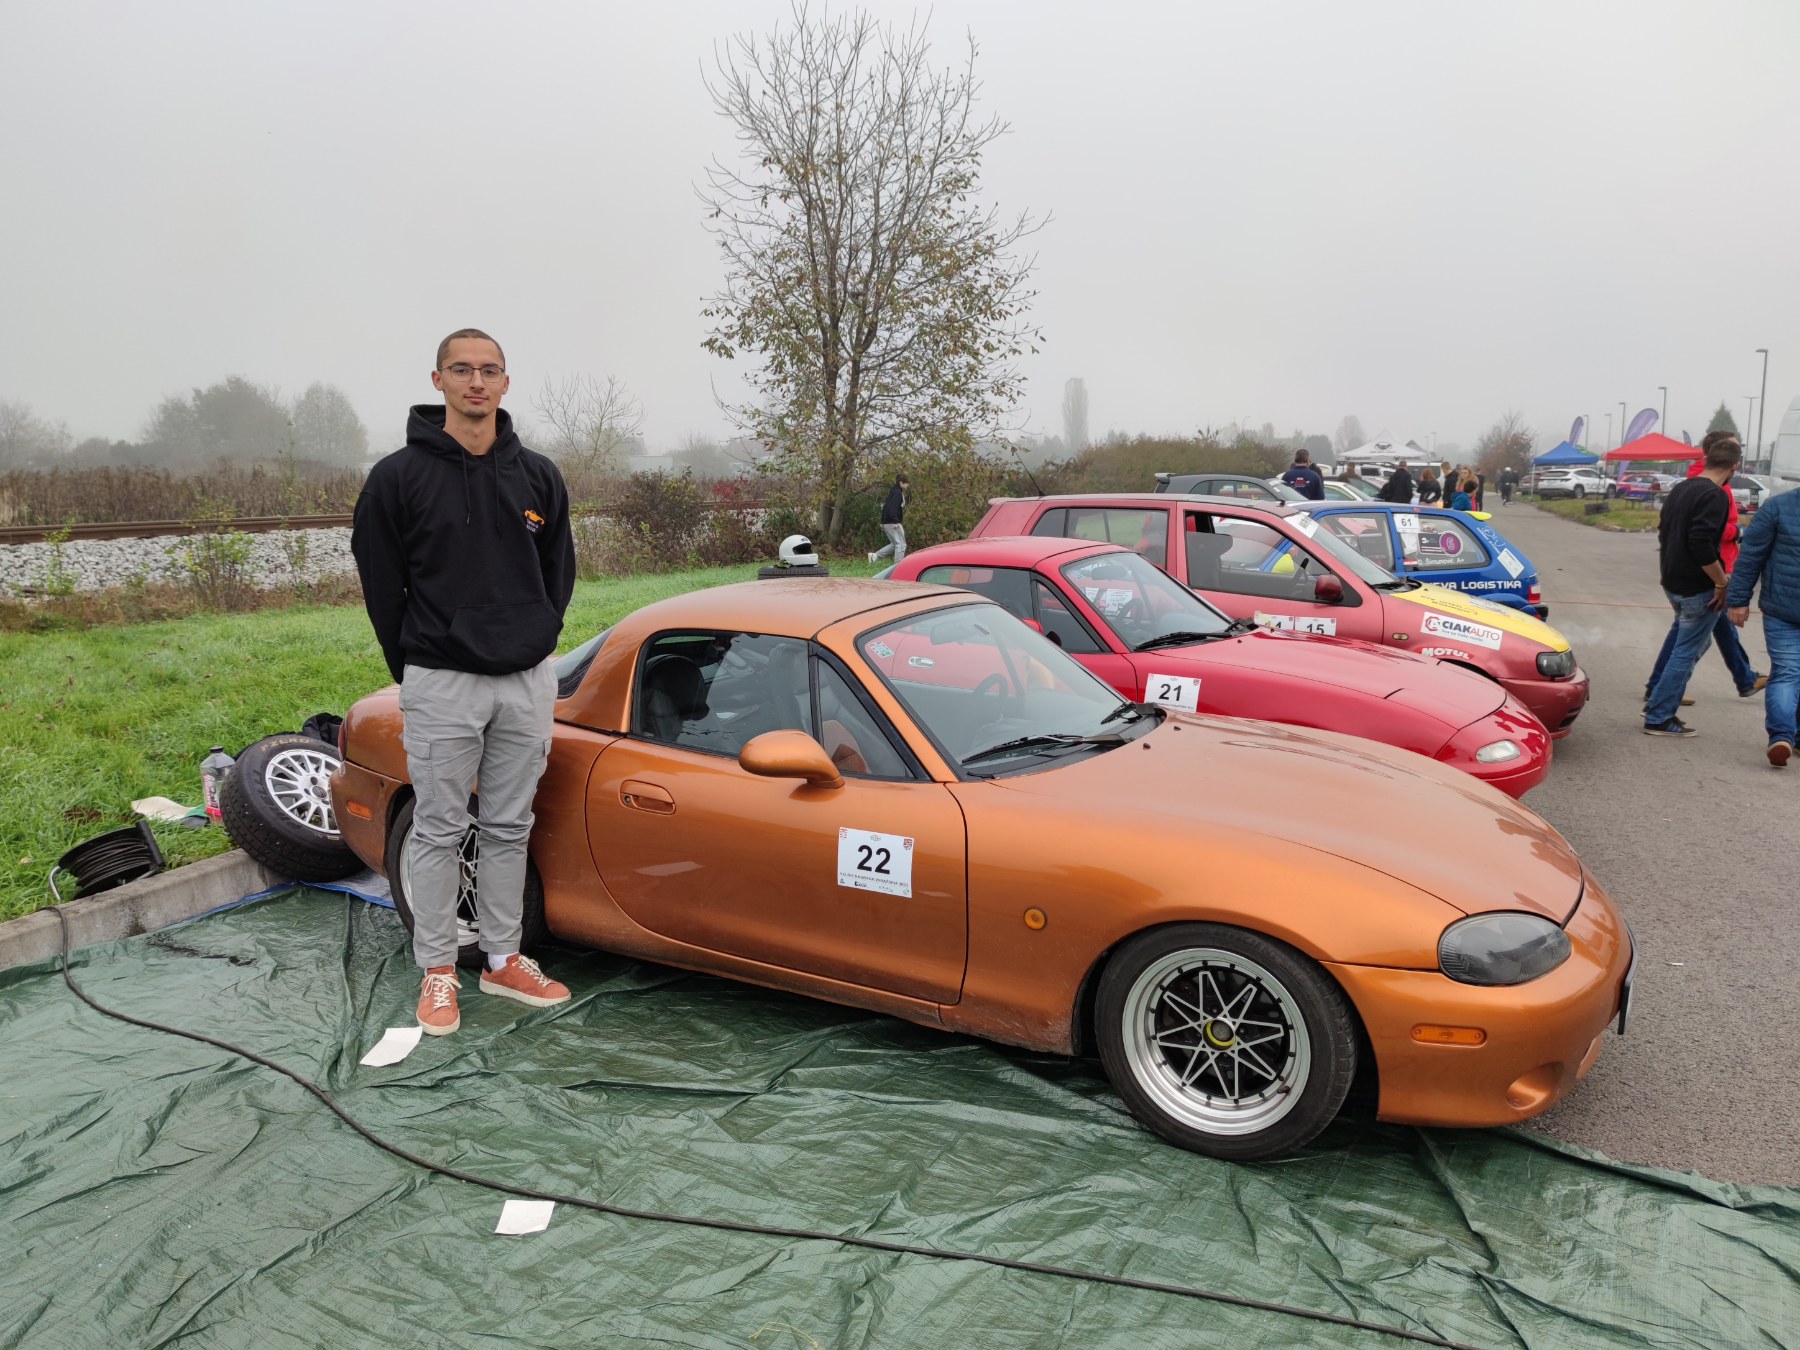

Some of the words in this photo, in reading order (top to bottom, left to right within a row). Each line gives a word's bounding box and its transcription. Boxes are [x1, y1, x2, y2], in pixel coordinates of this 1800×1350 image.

[1401, 518, 1412, 527] 61
[1461, 580, 1522, 590] LOGISTIKA
[1421, 647, 1470, 660] MOTUL
[1158, 683, 1182, 702] 21
[856, 844, 891, 875] 22
